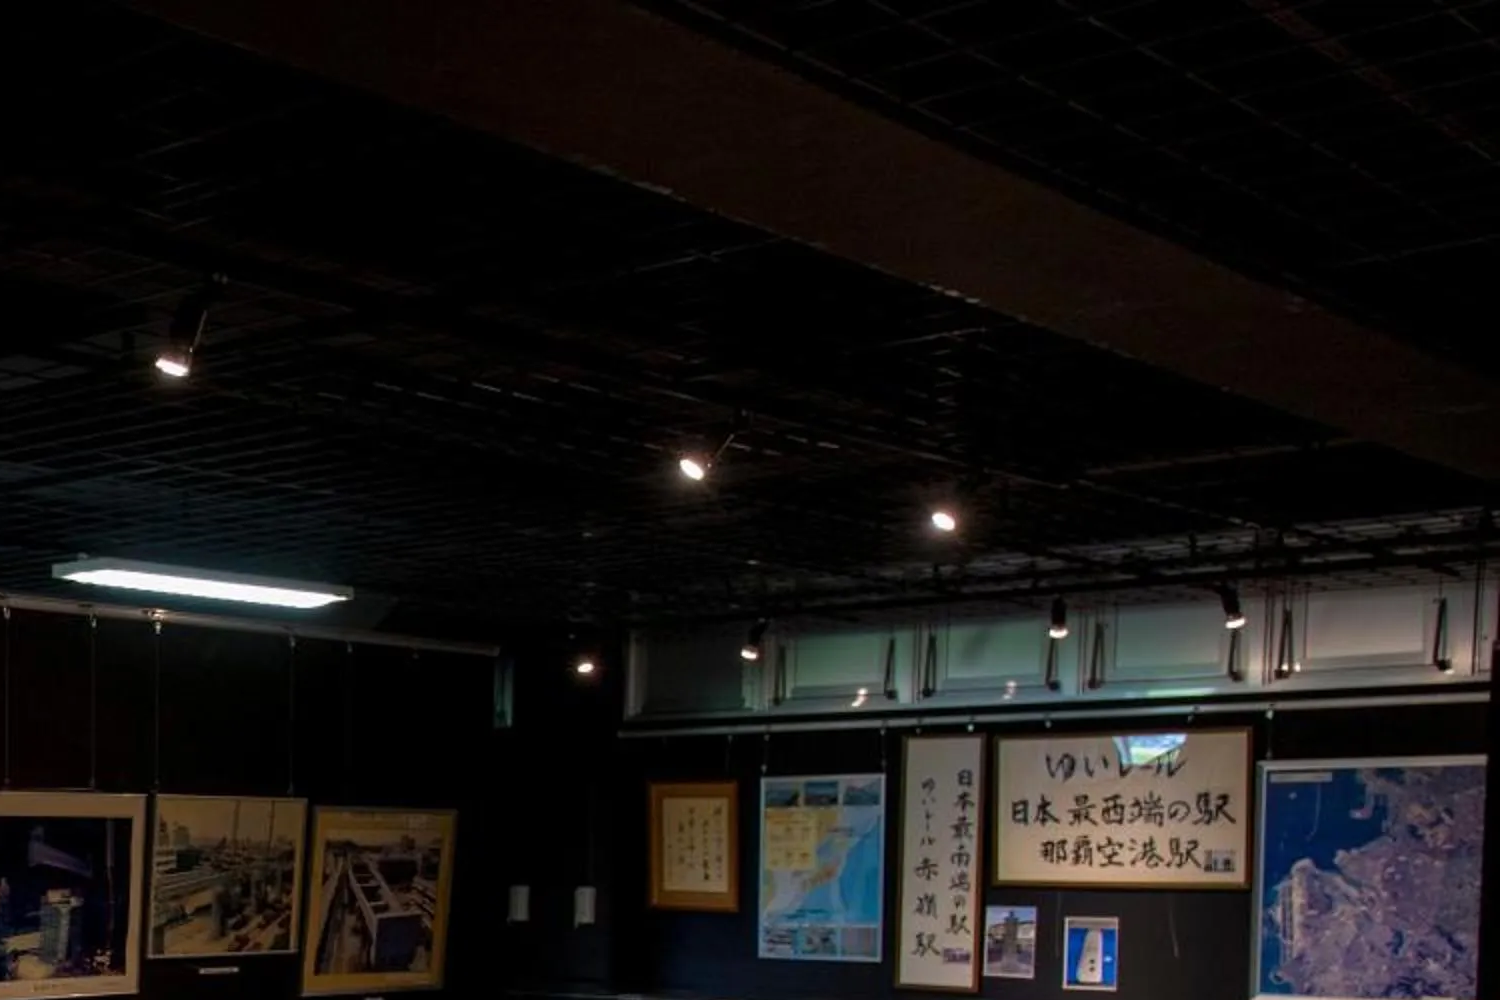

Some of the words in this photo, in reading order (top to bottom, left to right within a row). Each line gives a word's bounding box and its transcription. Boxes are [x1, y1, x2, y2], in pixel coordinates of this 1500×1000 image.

[1011, 790, 1237, 828] 日本最西端の駅
[945, 768, 975, 936] 日本最南端の駅
[1040, 834, 1204, 869] 那覇空港駅
